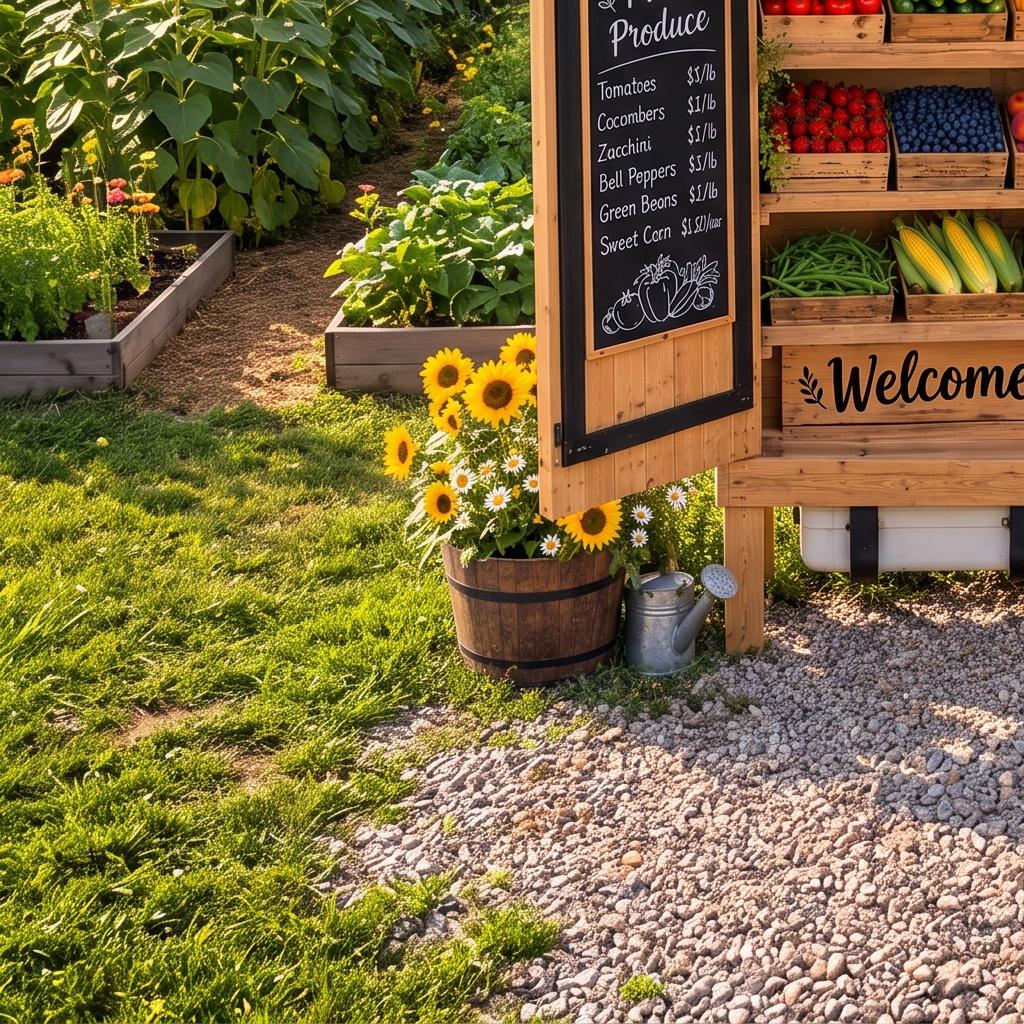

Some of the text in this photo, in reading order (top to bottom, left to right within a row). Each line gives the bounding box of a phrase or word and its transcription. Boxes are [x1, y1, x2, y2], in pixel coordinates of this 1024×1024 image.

[609, 7, 710, 57] Produce
[597, 77, 657, 101] Tomatoes
[597, 105, 666, 132] Cocombers
[597, 135, 653, 163] Zacchini
[600, 169, 624, 193] Bell
[627, 163, 677, 190] Peppers
[600, 202, 637, 223] Green
[600, 230, 639, 256] Sweet
